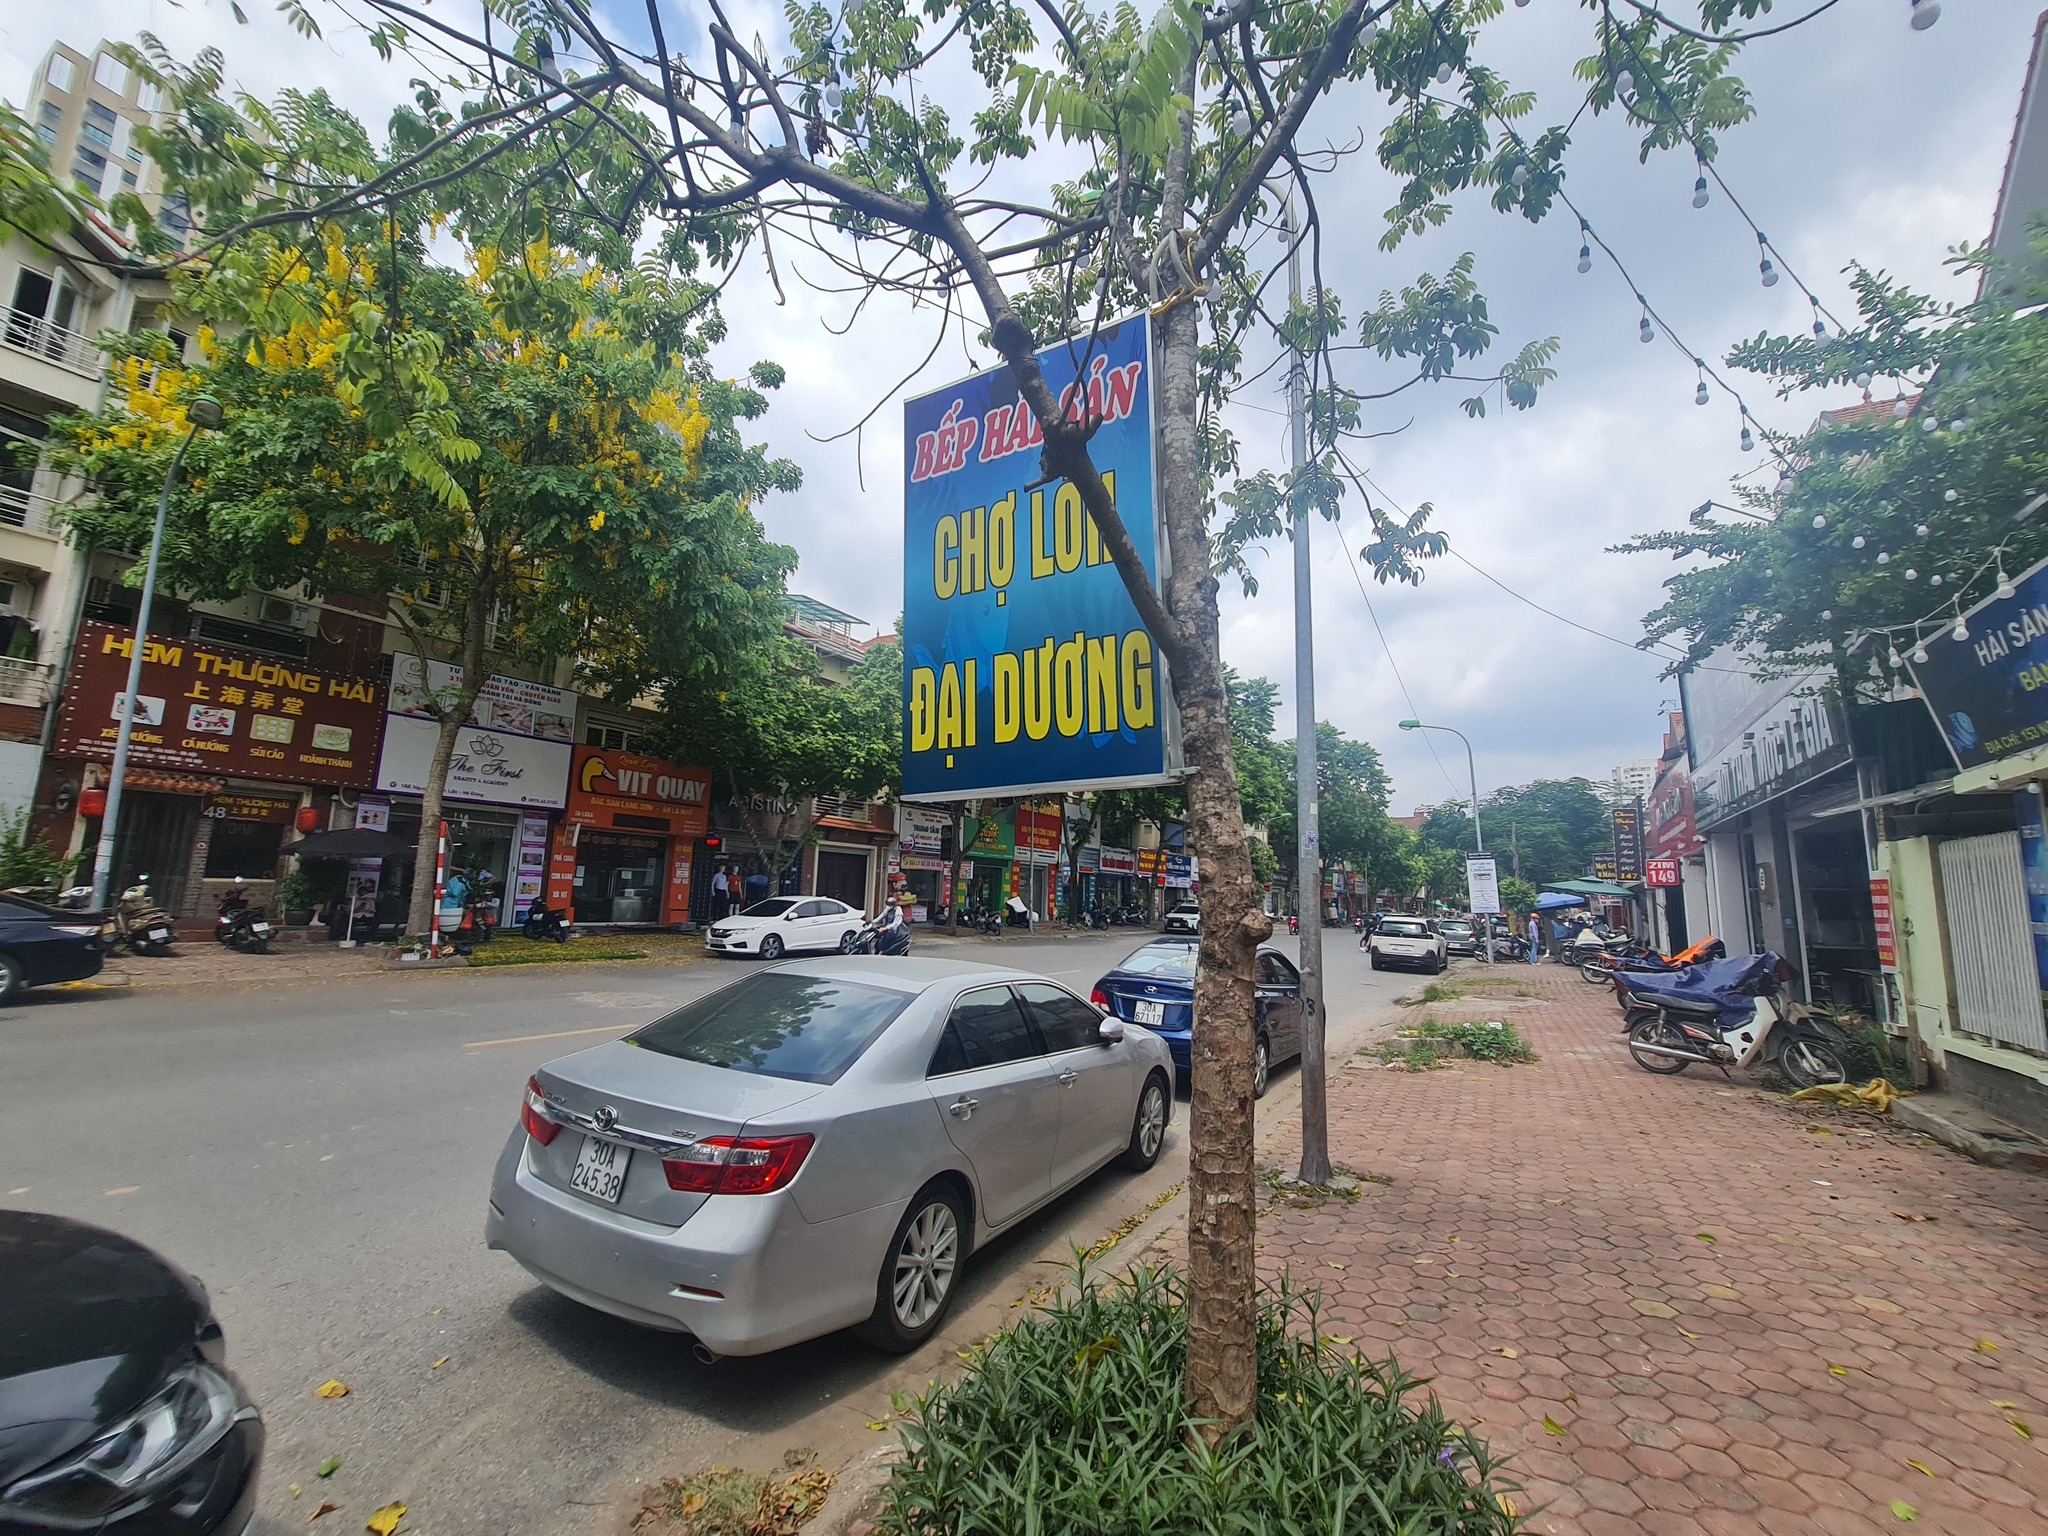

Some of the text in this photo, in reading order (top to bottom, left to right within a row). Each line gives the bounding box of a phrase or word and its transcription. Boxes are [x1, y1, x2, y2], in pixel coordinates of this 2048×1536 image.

[911, 398, 978, 483] BẾP
[1058, 353, 1142, 430] SẢN
[933, 490, 1016, 607] CHỢ
[1974, 629, 2010, 667] HẢI
[193, 651, 321, 694] THƯỢNG
[328, 678, 375, 704] HẢI
[488, 674, 502, 684] ÀO
[183, 680, 305, 715] 上海弄堂
[909, 628, 1156, 769] ĐẠI DƯƠNG
[1801, 697, 1834, 760] GIA
[2021, 726, 2041, 741] 153
[182, 737, 199, 749] CÁ
[199, 739, 230, 753] NƯỚNG
[447, 753, 524, 780] The First
[453, 775, 477, 783] BEAUTY
[618, 768, 706, 802] VỊT QUAY
[203, 806, 226, 819] 48
[1648, 861, 1675, 869] ZIM
[1649, 870, 1676, 883] 149
[1134, 1011, 1161, 1024] 671.17
[1142, 1002, 1156, 1013] 30A
[671, 1128, 697, 1139] 250
[590, 1138, 616, 1170] 30A
[572, 1163, 621, 1201] 245.38
